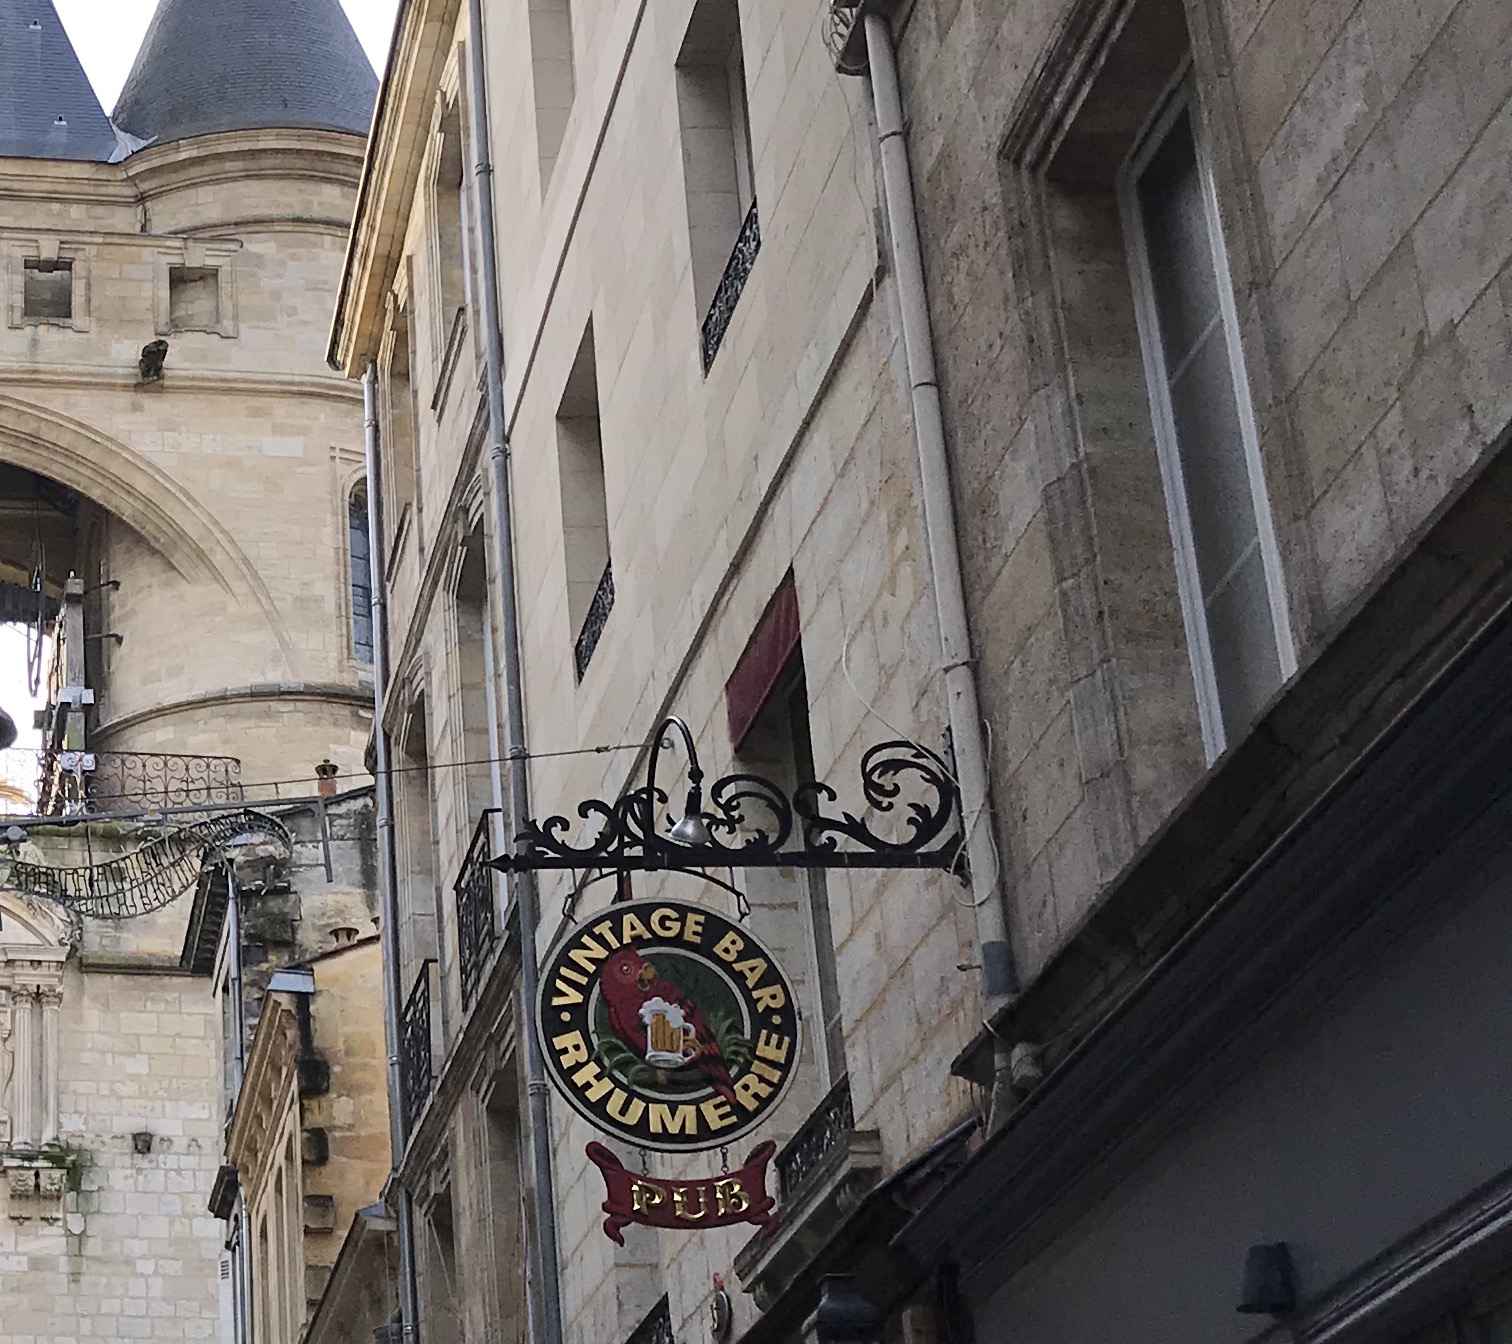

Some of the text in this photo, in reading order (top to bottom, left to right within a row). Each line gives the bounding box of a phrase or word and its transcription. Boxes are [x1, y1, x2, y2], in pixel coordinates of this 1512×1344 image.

[551, 907, 786, 1013] VINTAGE BAR
[551, 1028, 791, 1135] RHUMERIE
[631, 1177, 750, 1220] PUB
